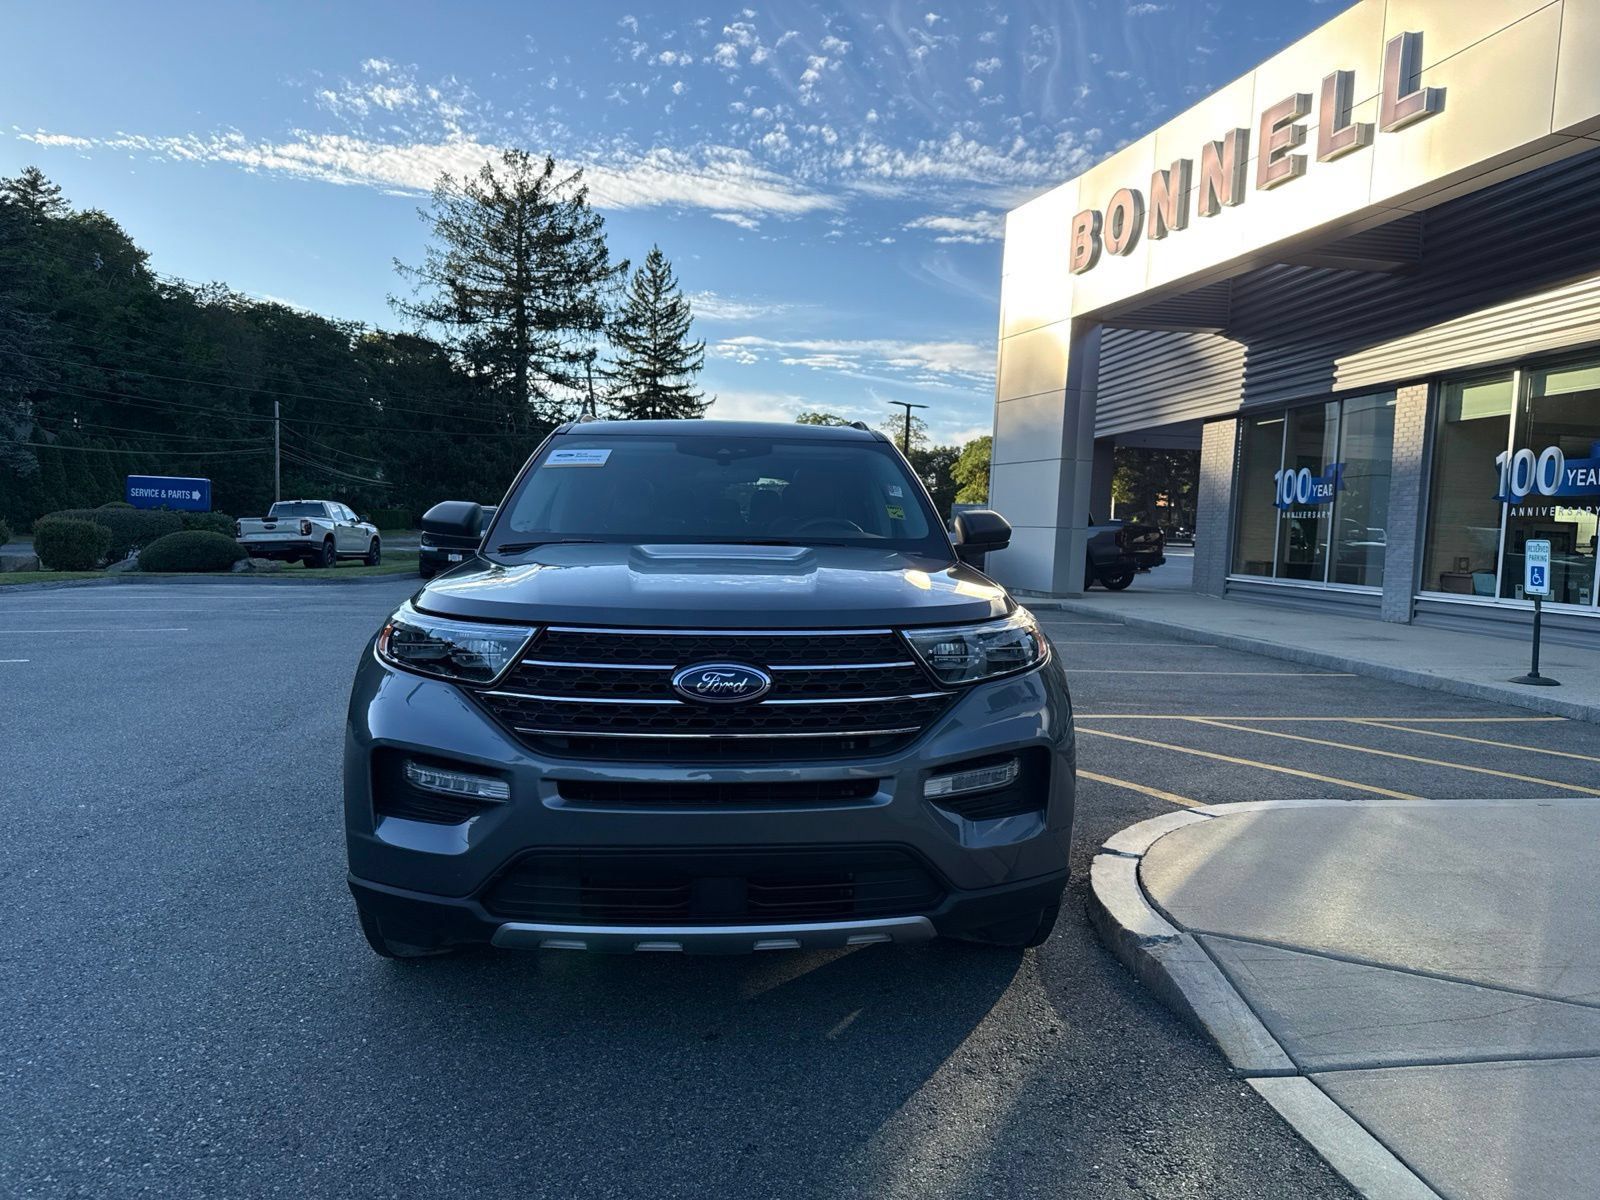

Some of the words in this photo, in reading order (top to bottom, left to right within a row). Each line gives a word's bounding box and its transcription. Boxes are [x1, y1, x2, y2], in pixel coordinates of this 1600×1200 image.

[1070, 31, 1447, 275] BONNELL
[1496, 446, 1565, 497] 100
[1567, 469, 1600, 486] YEA
[130, 488, 159, 498] SERVICE
[161, 489, 166, 498] &
[167, 490, 191, 499] PARTS
[1275, 467, 1312, 504] 100
[1510, 506, 1600, 517] ANNIVERSARY
[1528, 545, 1548, 553] RESERVED
[1529, 554, 1547, 562] PARKING
[697, 671, 748, 693] Ford
